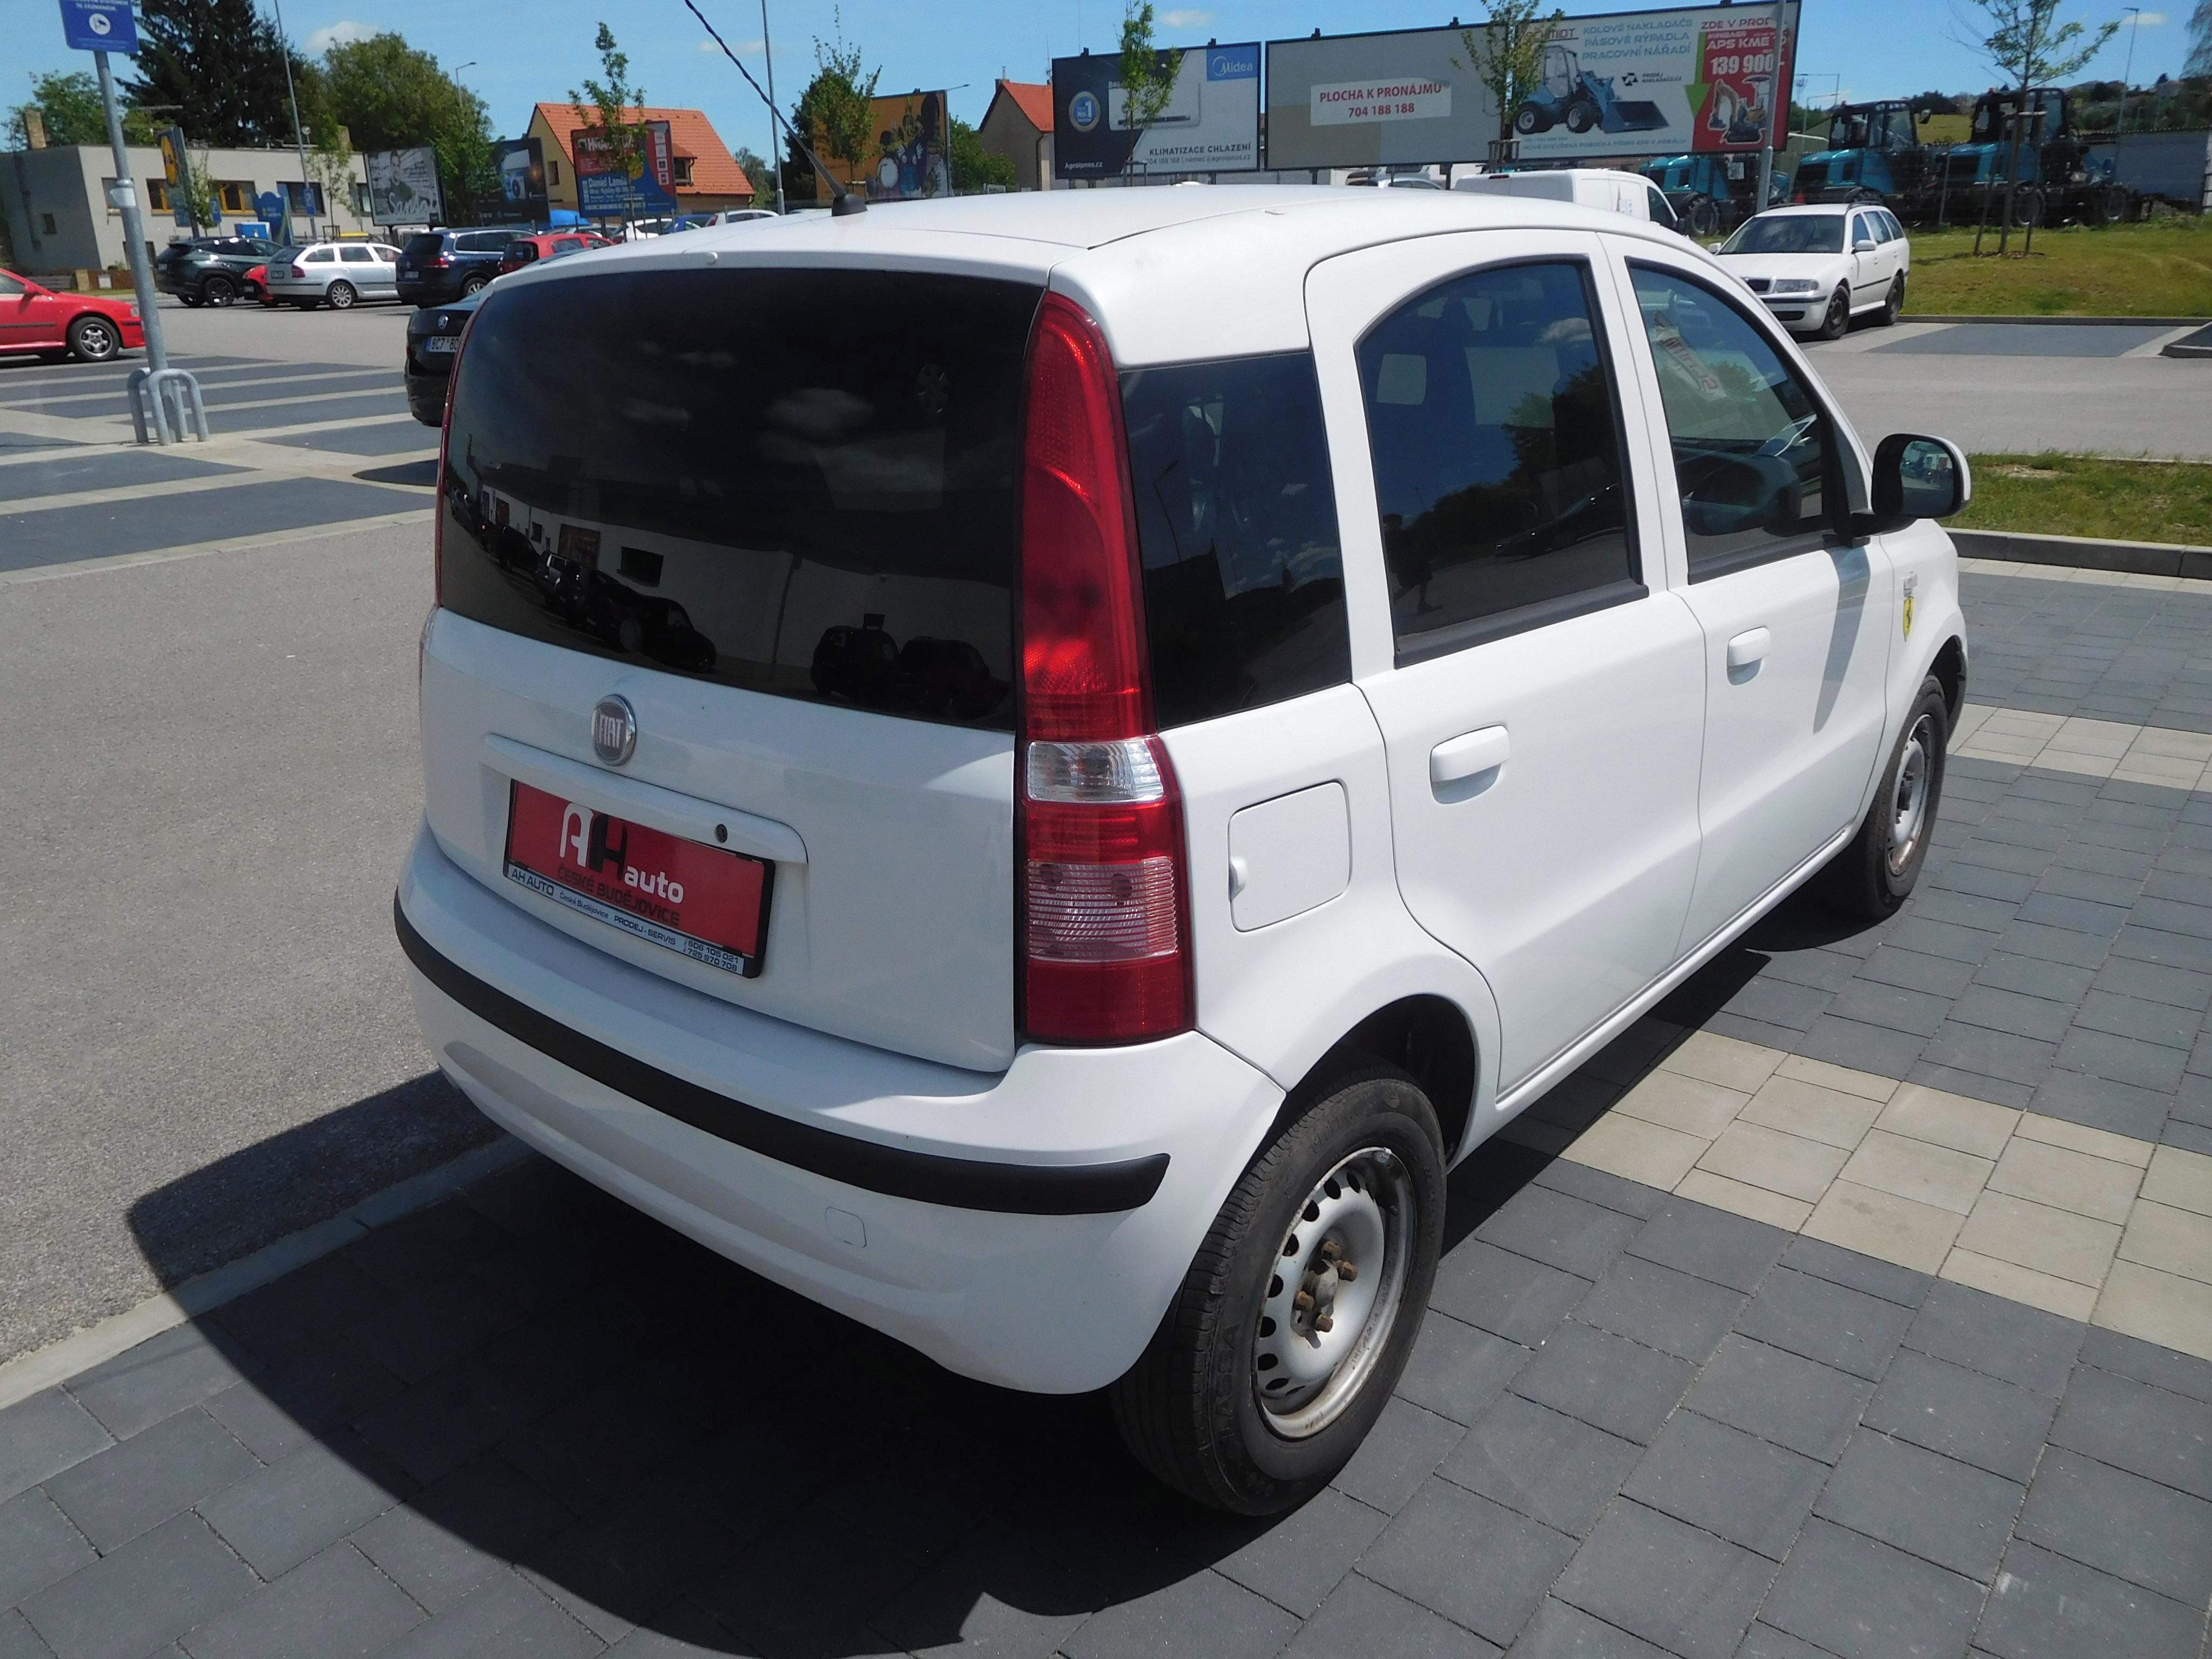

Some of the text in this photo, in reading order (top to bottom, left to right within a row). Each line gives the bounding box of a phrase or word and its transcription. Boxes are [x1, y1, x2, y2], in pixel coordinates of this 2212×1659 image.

[1701, 21, 1724, 29] ZDE
[1728, 19, 1736, 28] V
[1706, 39, 1736, 50] APS
[1738, 36, 1770, 48] KME
[1219, 61, 1253, 75] Midea
[1710, 55, 1739, 75] 139
[1320, 82, 1442, 103] PLOCHA K PRONÁJMU
[1348, 103, 1415, 118] 704 188 188
[1149, 141, 1252, 156] KLIMATIZACE CHLAZENÍ
[598, 713, 624, 749] FIAT
[597, 882, 681, 926] BUDĚJOVICE
[511, 868, 525, 884] AH
[526, 877, 554, 896] AUTO
[706, 947, 722, 958] 105
[722, 953, 739, 964] 021
[687, 948, 703, 959] 725
[721, 960, 738, 972] 708
